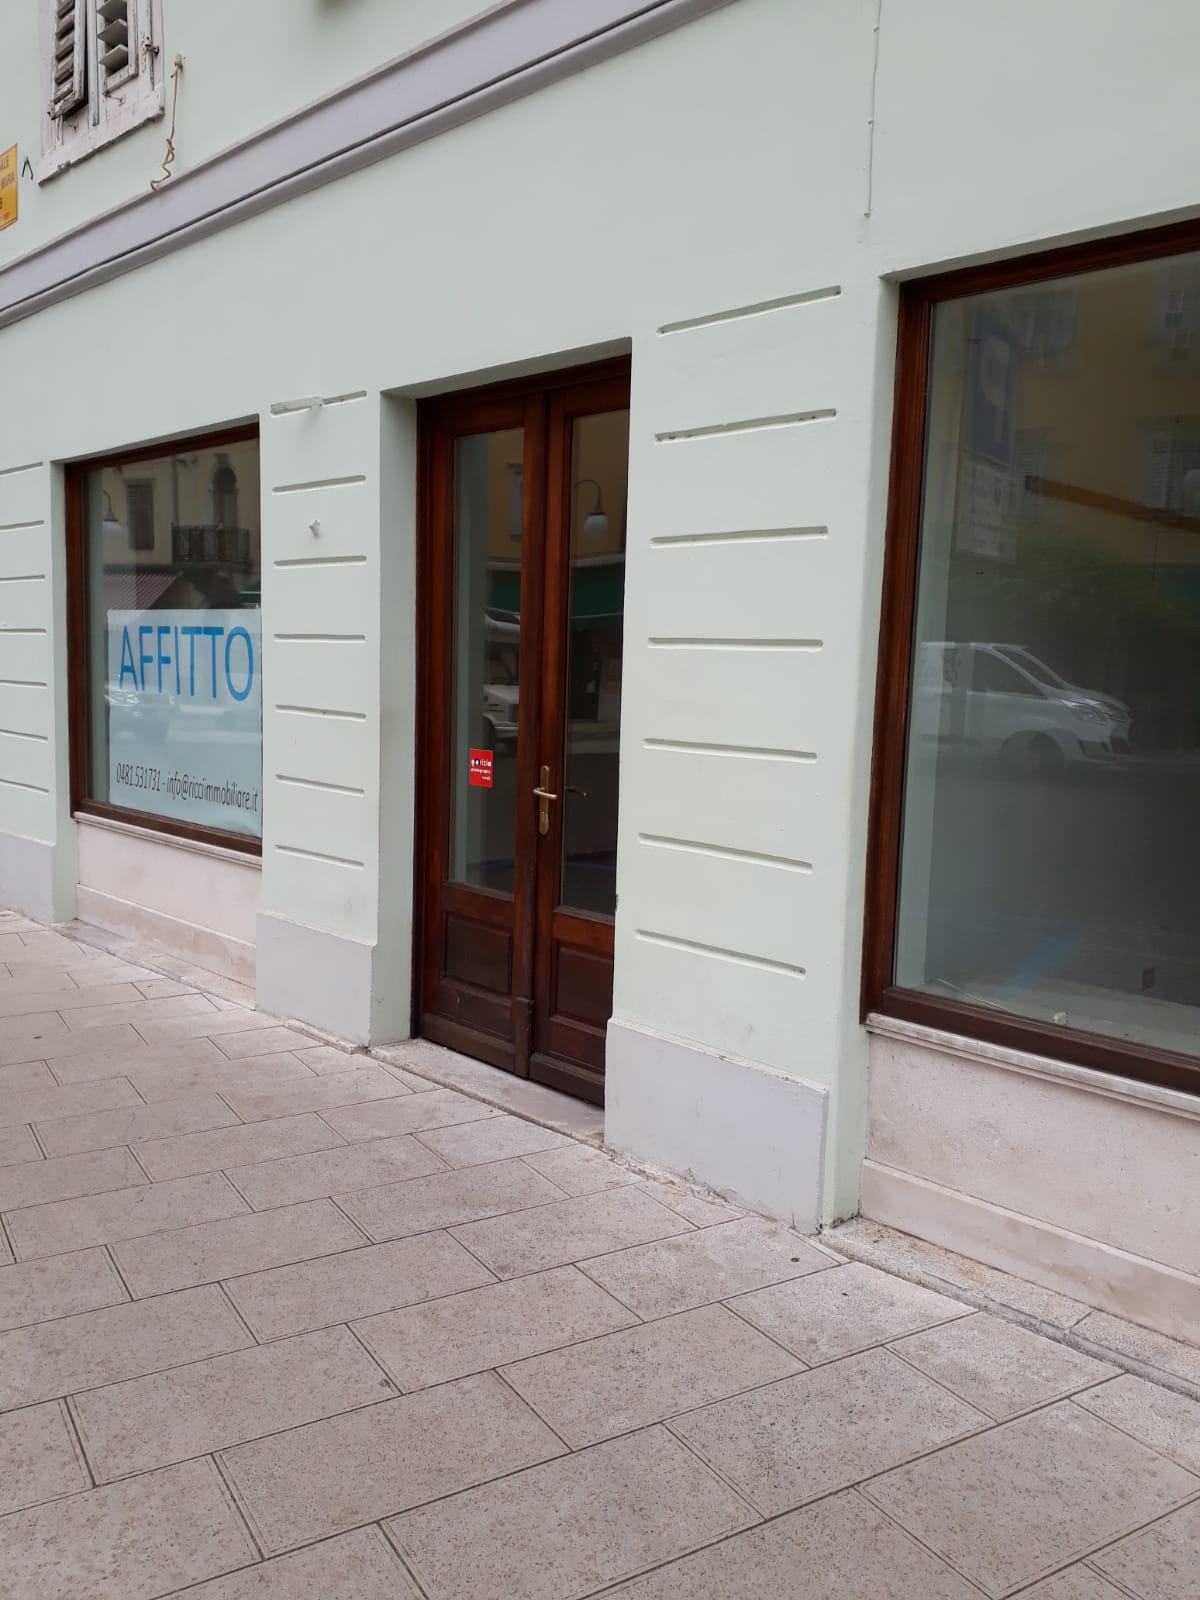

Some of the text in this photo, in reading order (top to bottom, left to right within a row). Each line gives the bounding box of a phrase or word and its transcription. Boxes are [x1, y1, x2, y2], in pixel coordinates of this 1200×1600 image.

[119, 624, 254, 702] AFFITTO
[116, 762, 161, 792] 0481.531731
[166, 771, 259, 812] info@ricciimmobiliare.it
